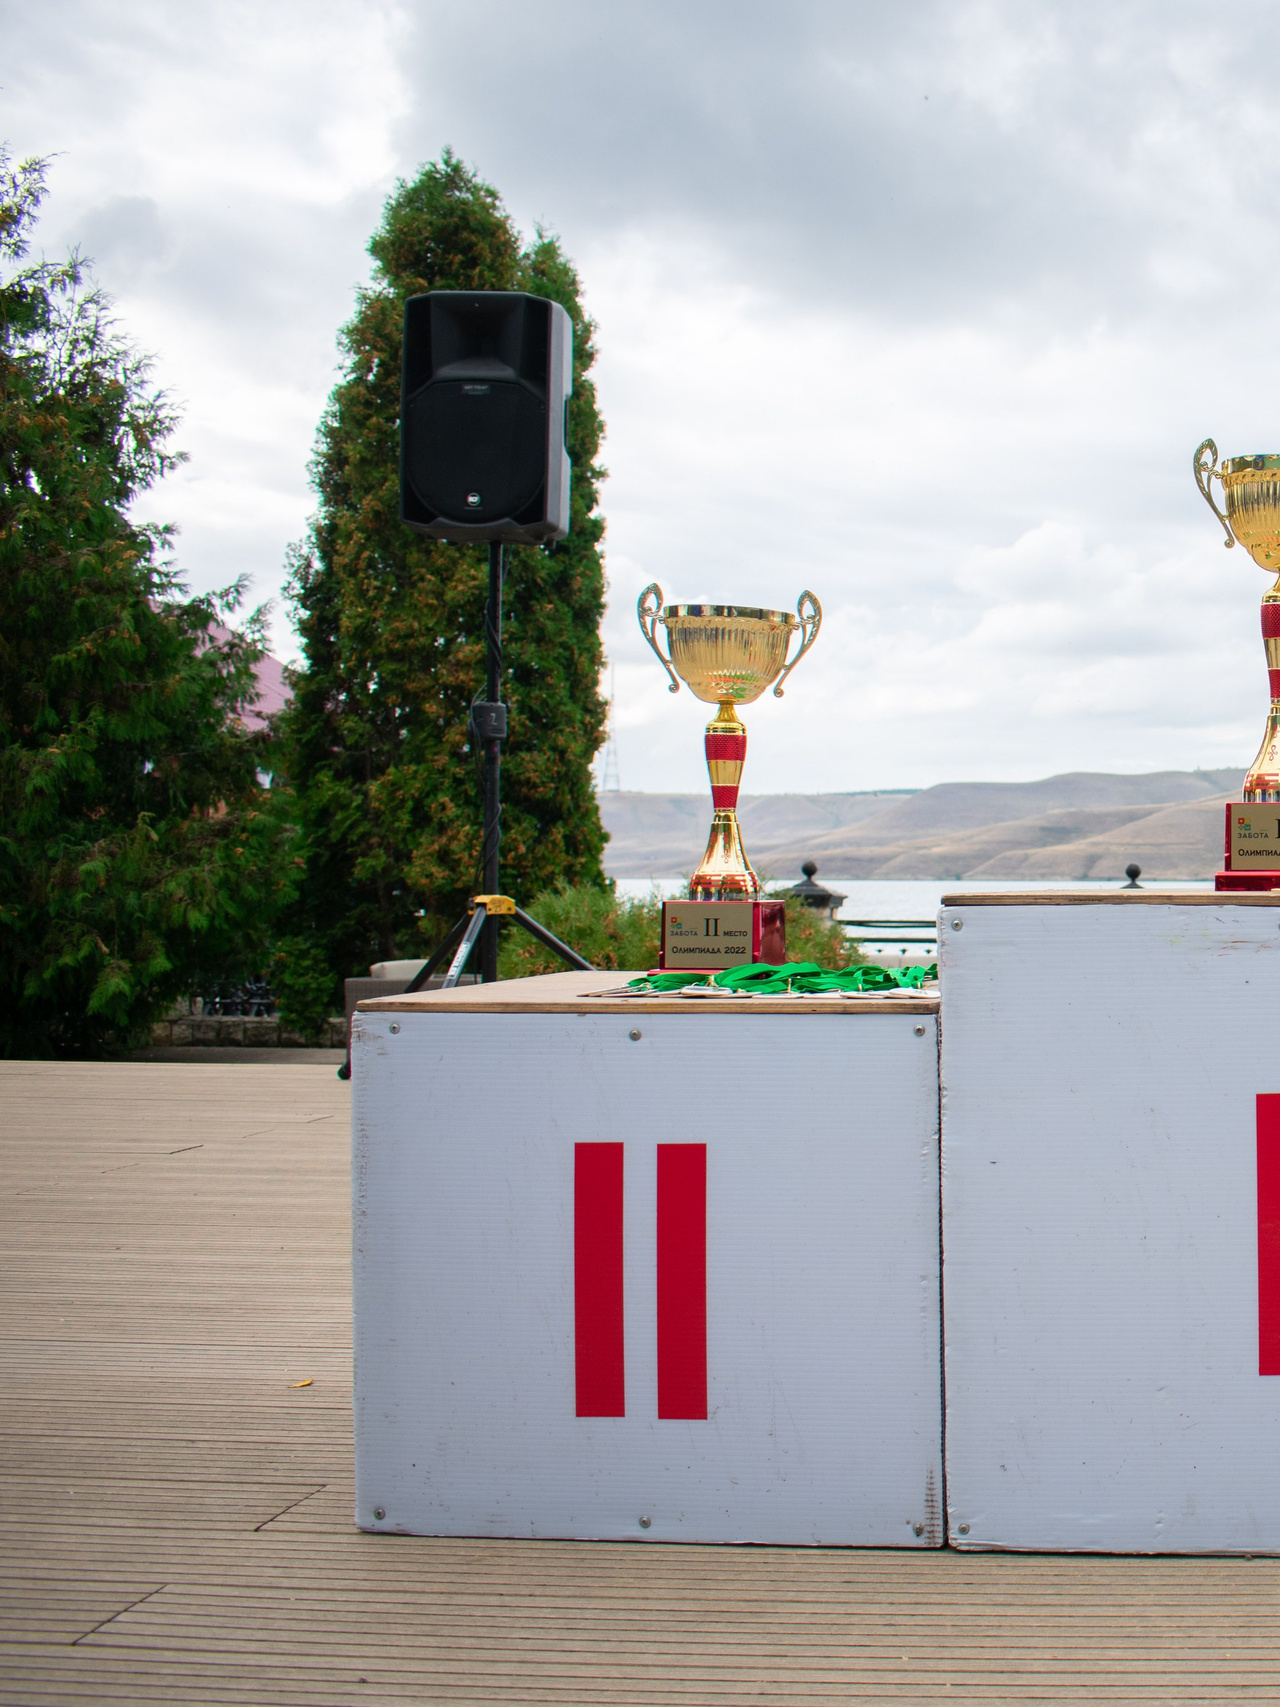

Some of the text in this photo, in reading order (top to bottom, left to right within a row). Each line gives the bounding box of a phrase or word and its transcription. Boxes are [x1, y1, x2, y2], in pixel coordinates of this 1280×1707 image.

[703, 917, 720, 937] II
[724, 946, 747, 954] 2022
[575, 1143, 708, 1420] II
